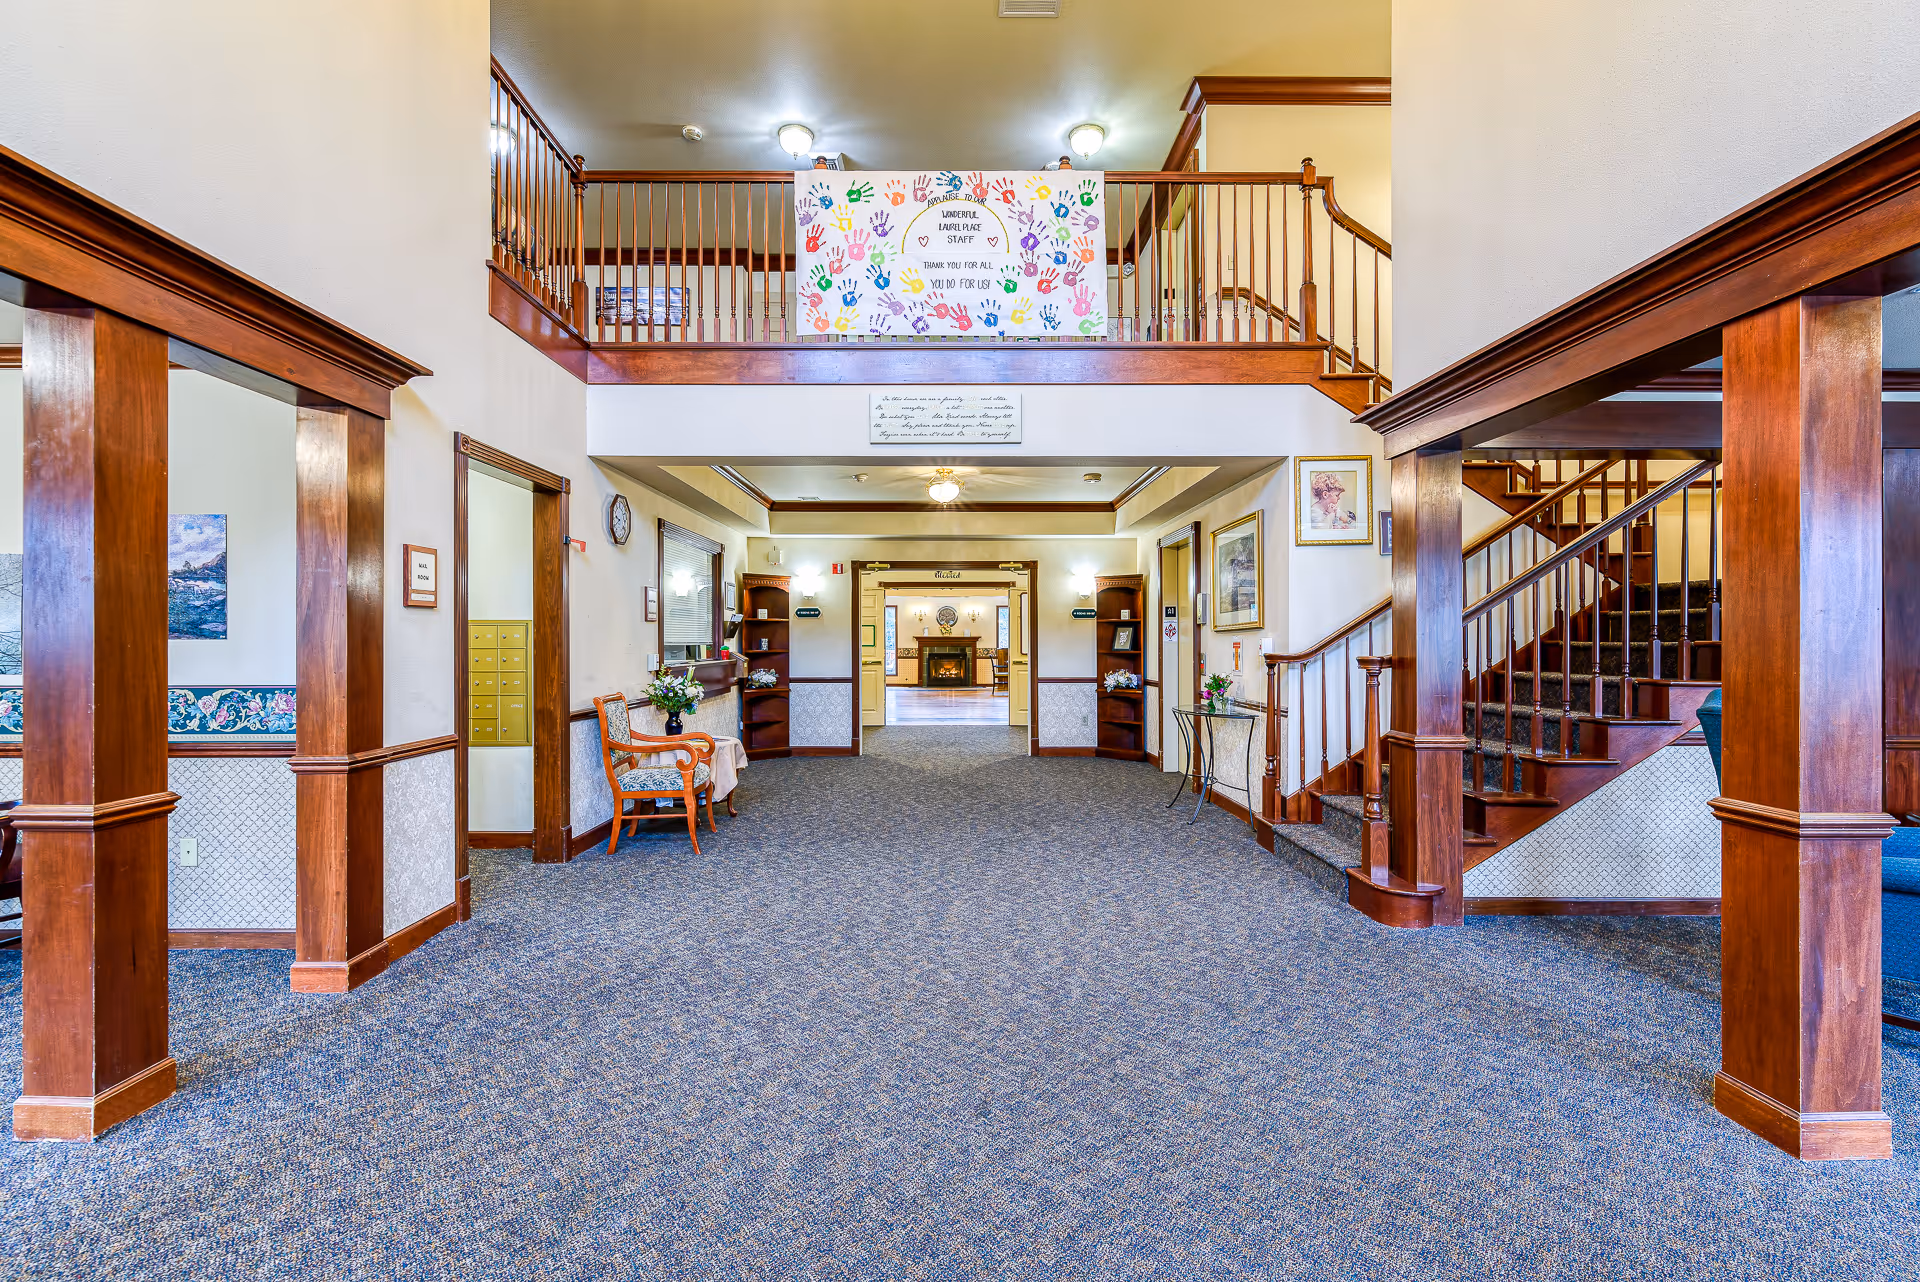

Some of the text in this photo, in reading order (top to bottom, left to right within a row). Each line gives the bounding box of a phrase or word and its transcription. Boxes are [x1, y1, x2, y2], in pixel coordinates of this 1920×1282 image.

[927, 192, 987, 208] APPLAUSE TO OUR
[942, 210, 980, 219] WONDERFUL
[938, 222, 982, 232] LAUREL PLACE
[947, 234, 974, 244] STAFF
[924, 261, 994, 270] THANK YOU FOR ALL
[930, 278, 990, 290] YOU DO FOR US!
